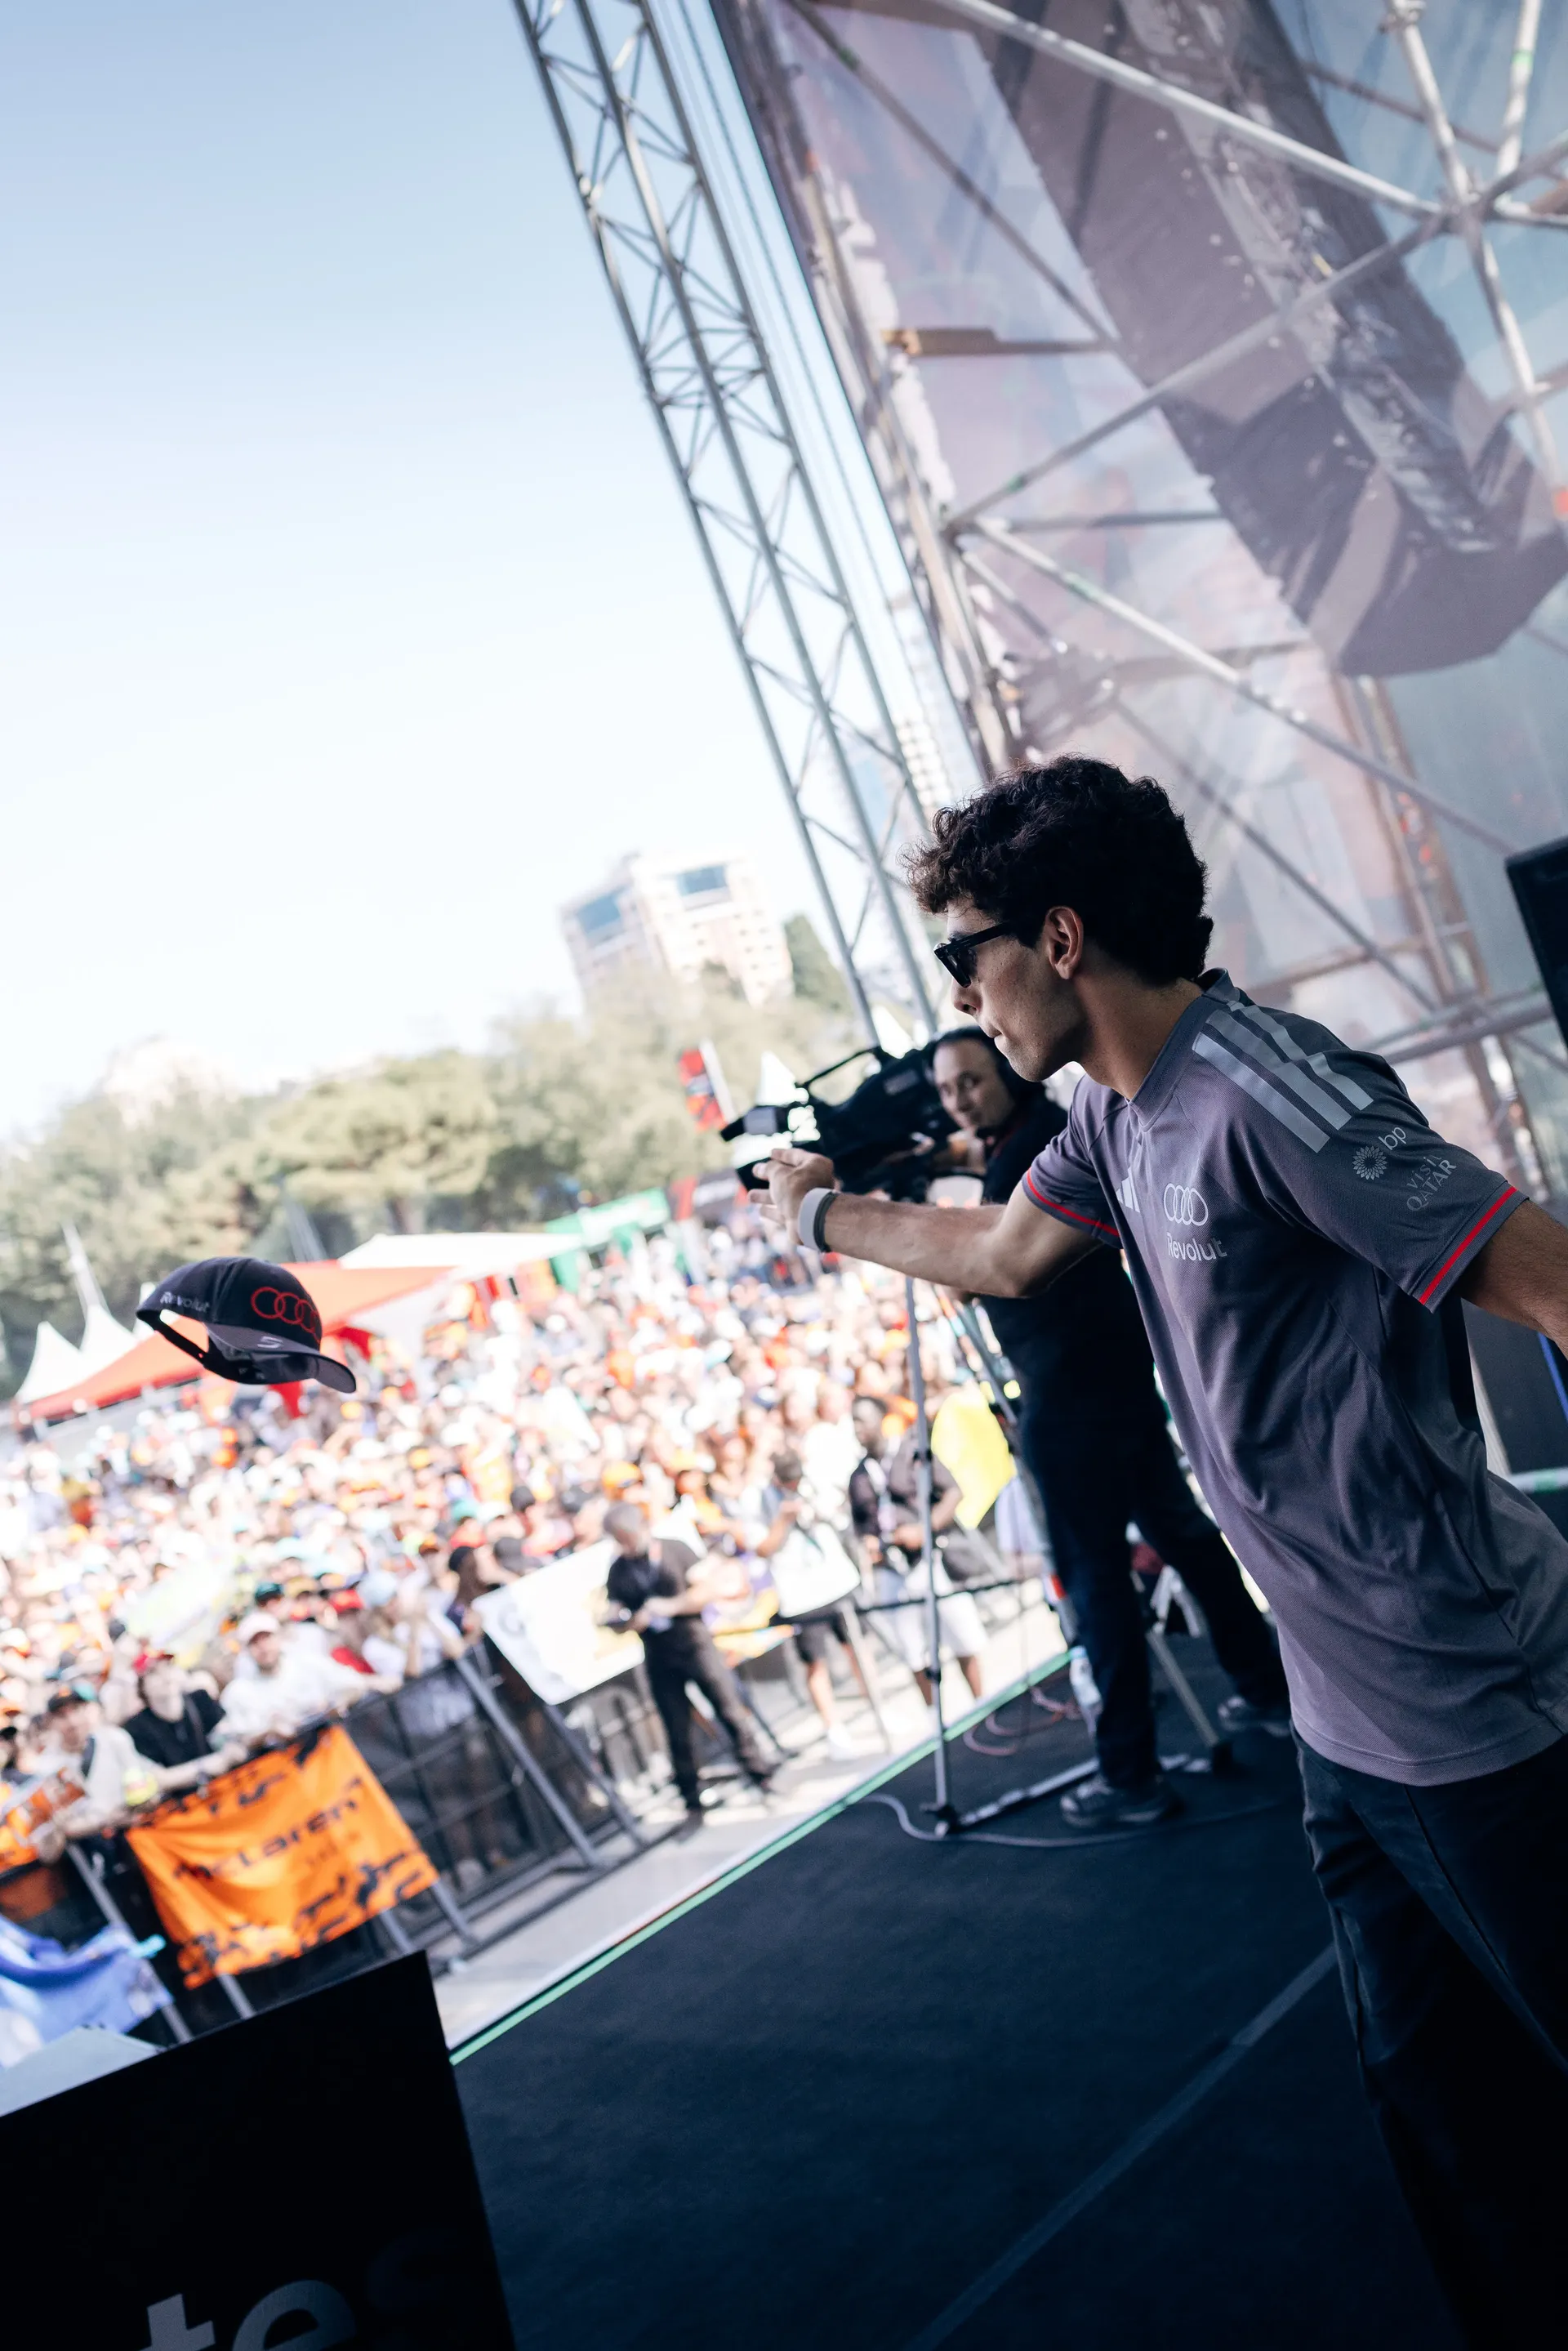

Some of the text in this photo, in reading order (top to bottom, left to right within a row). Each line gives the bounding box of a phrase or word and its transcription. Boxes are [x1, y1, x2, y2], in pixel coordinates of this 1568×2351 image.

[1378, 1126, 1406, 1151] bp
[1406, 1159, 1457, 1211] QATAR
[1166, 1232, 1227, 1261] Revolut
[160, 1291, 210, 1313] Revolut
[173, 1797, 358, 1880] cLaren
